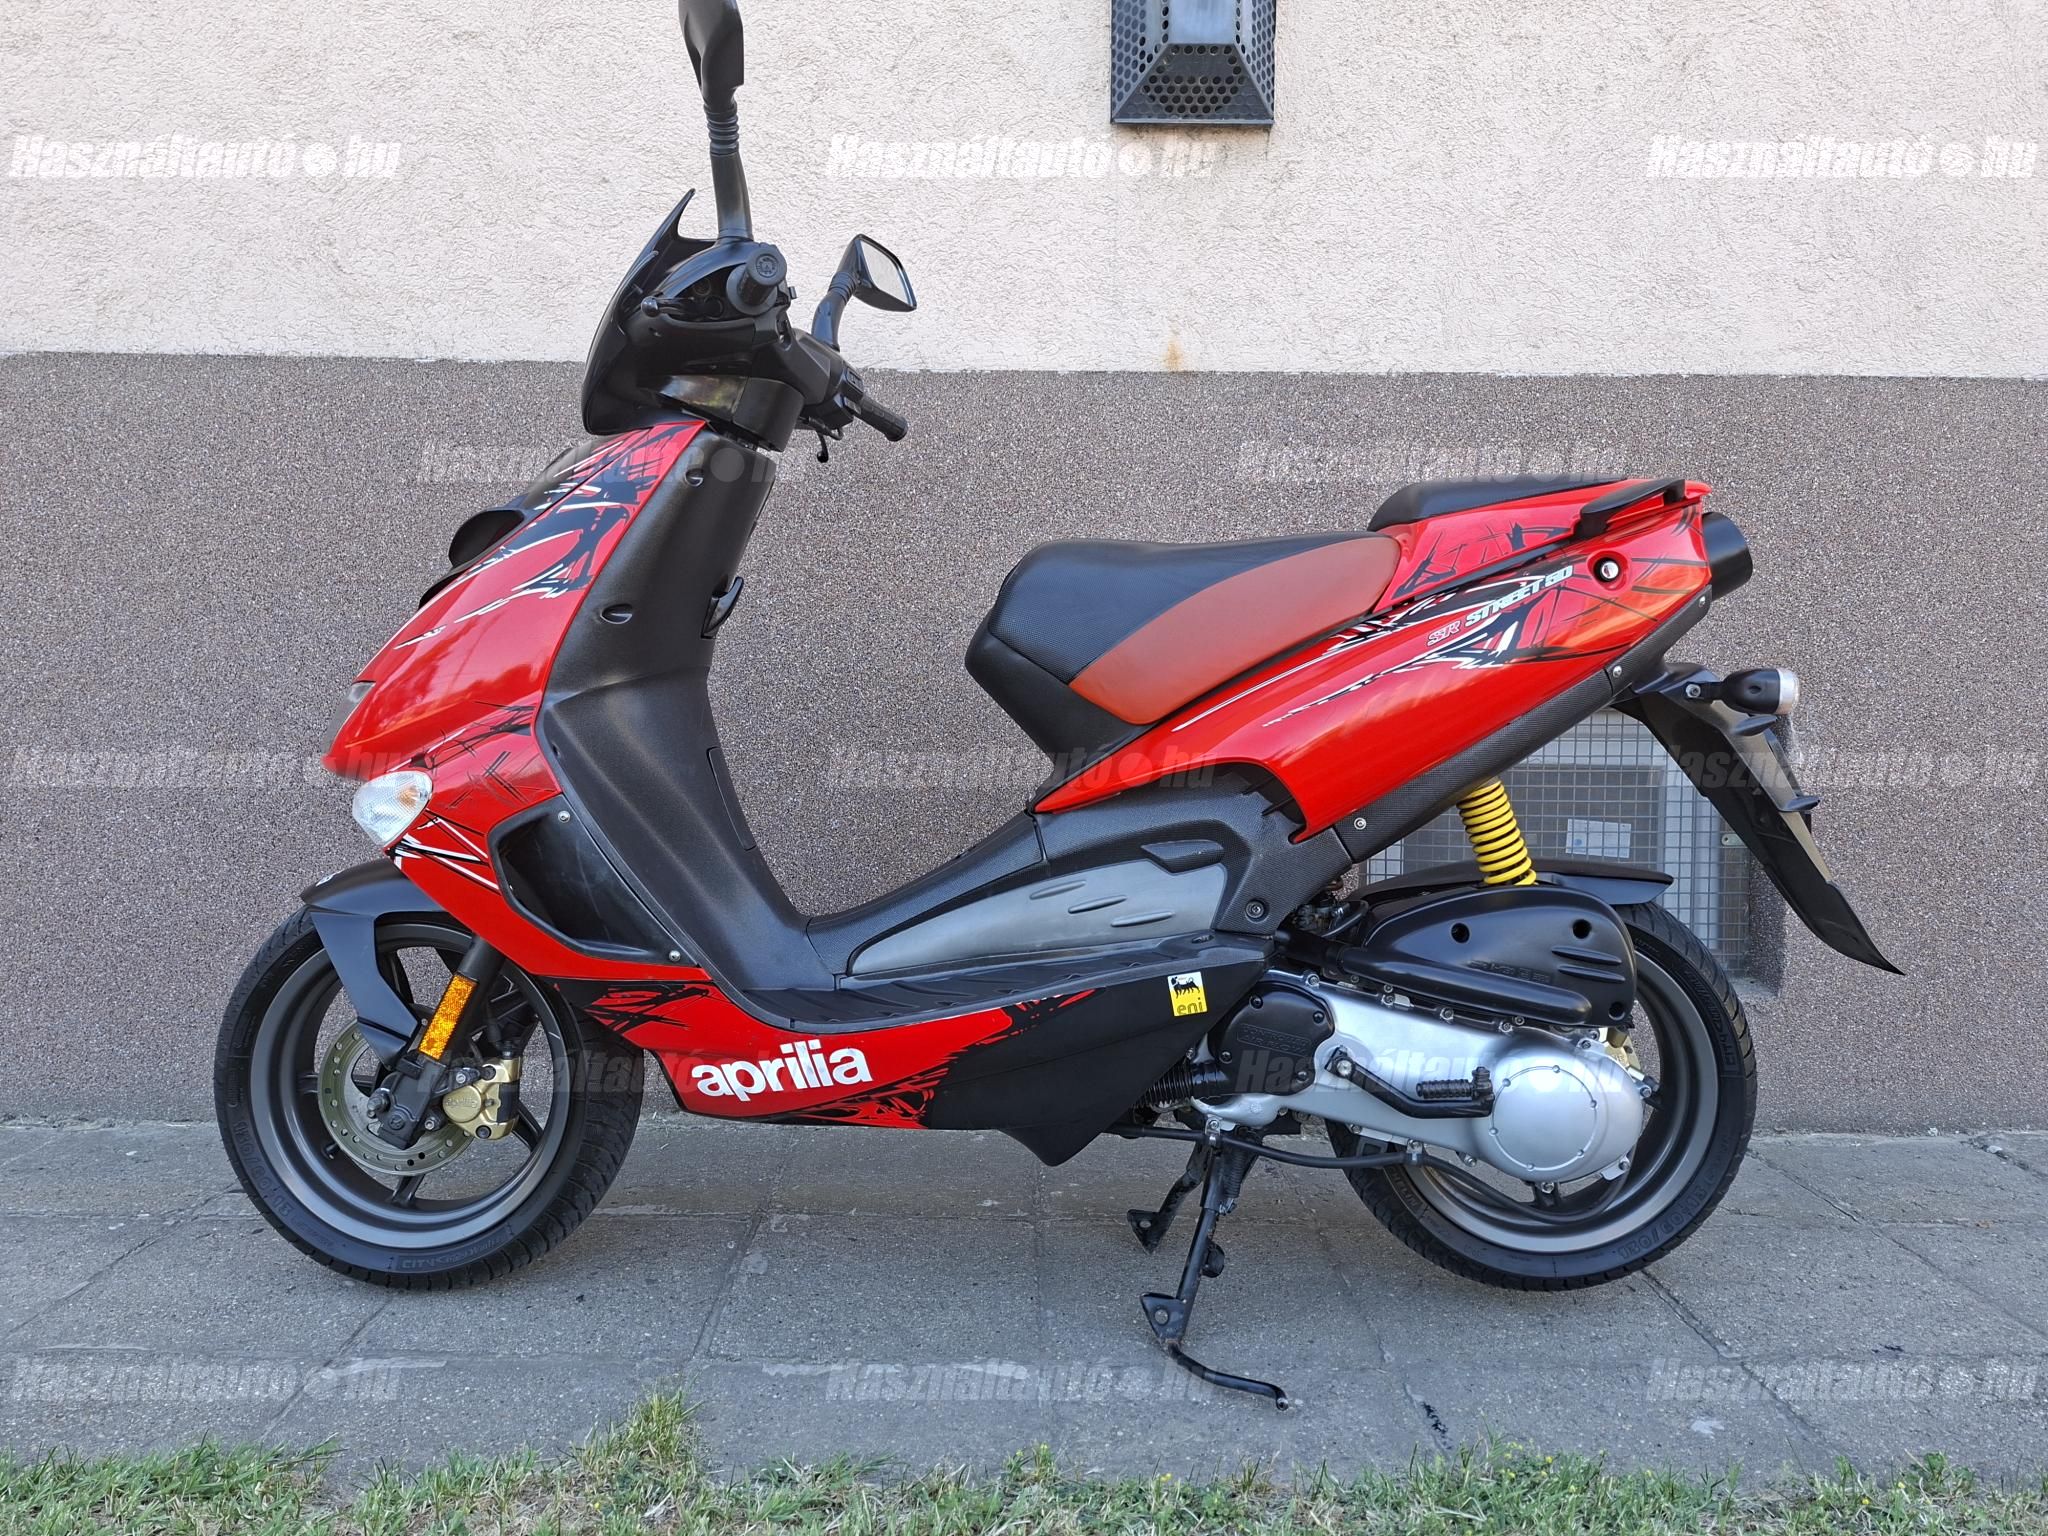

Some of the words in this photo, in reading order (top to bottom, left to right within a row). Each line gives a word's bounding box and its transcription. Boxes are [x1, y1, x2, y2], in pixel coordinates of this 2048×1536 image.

[1427, 620, 1461, 646] SR
[1466, 576, 1545, 627] STREET
[1176, 996, 1204, 1015] eni
[691, 1039, 873, 1101] aprilia
